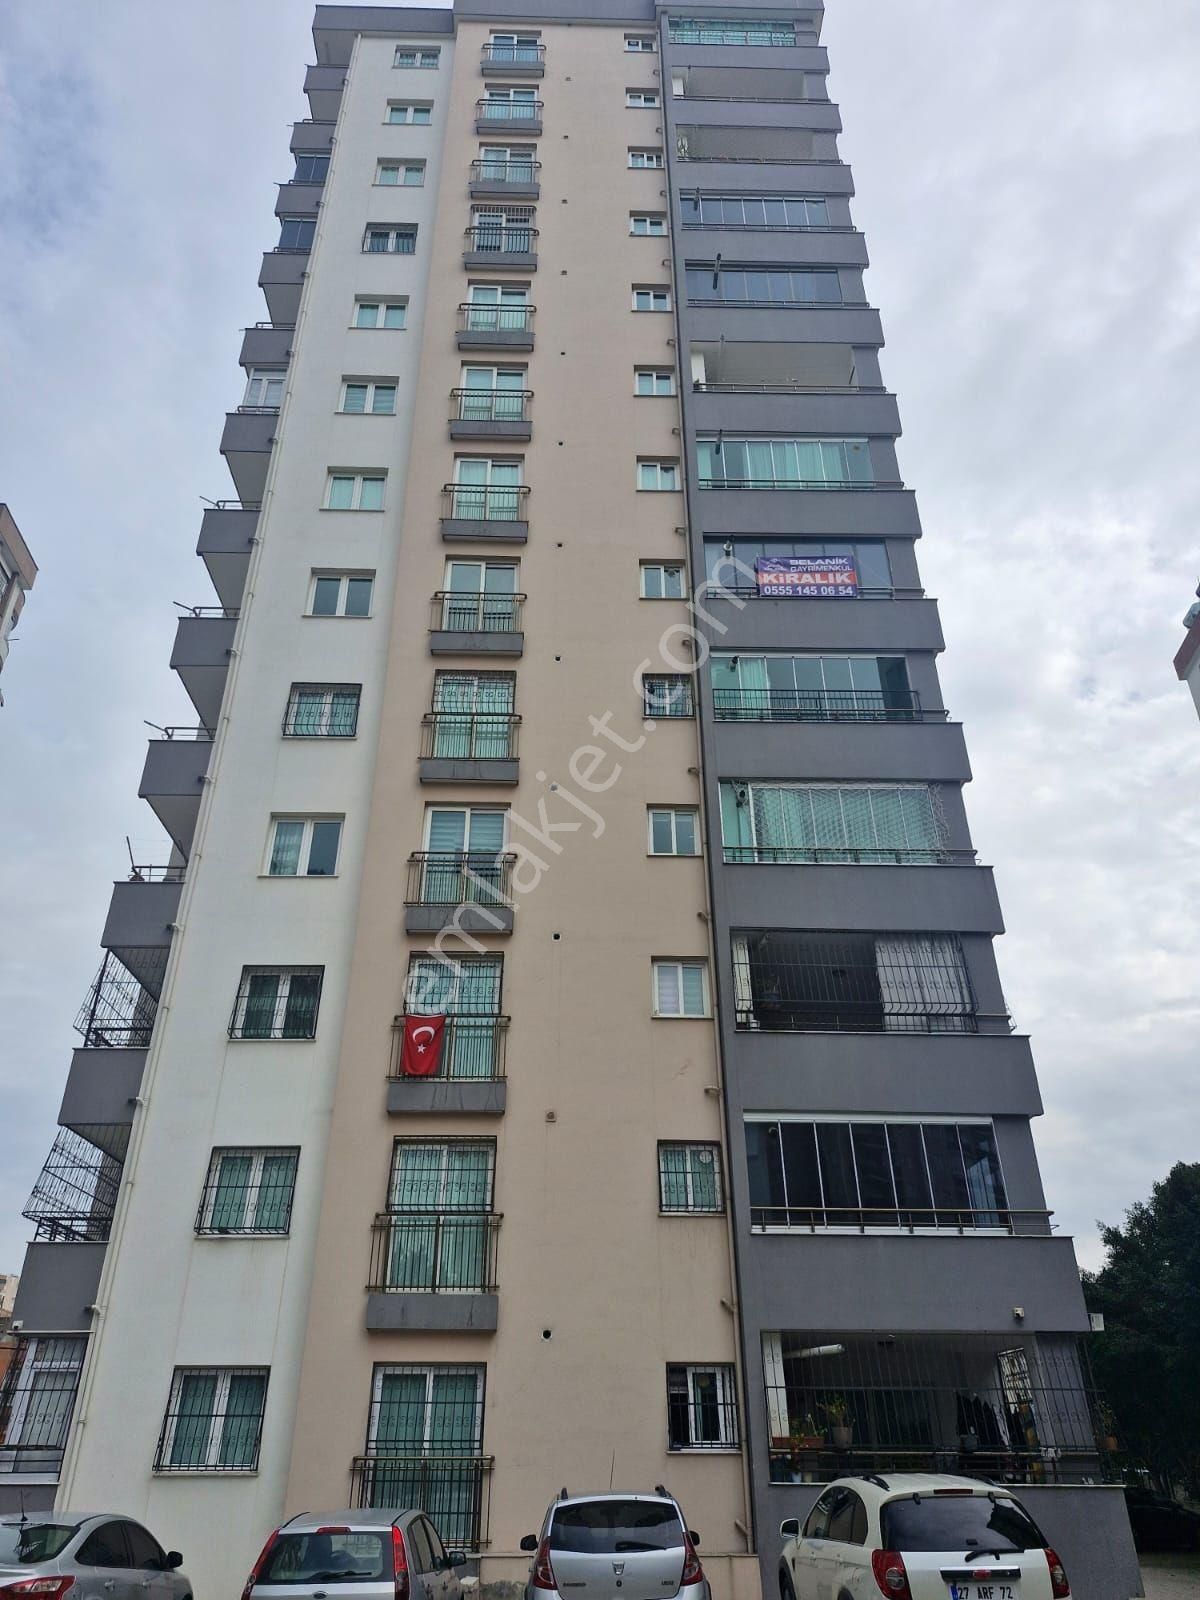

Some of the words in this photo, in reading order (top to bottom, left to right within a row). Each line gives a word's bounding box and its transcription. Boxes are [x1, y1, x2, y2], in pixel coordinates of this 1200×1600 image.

[764, 585, 793, 596] 0555
[796, 585, 818, 596] 145
[820, 585, 836, 596] 06
[838, 585, 854, 596] 54
[957, 1586, 970, 1600] 27
[977, 1586, 995, 1600] ARF
[999, 1586, 1014, 1600] 72
